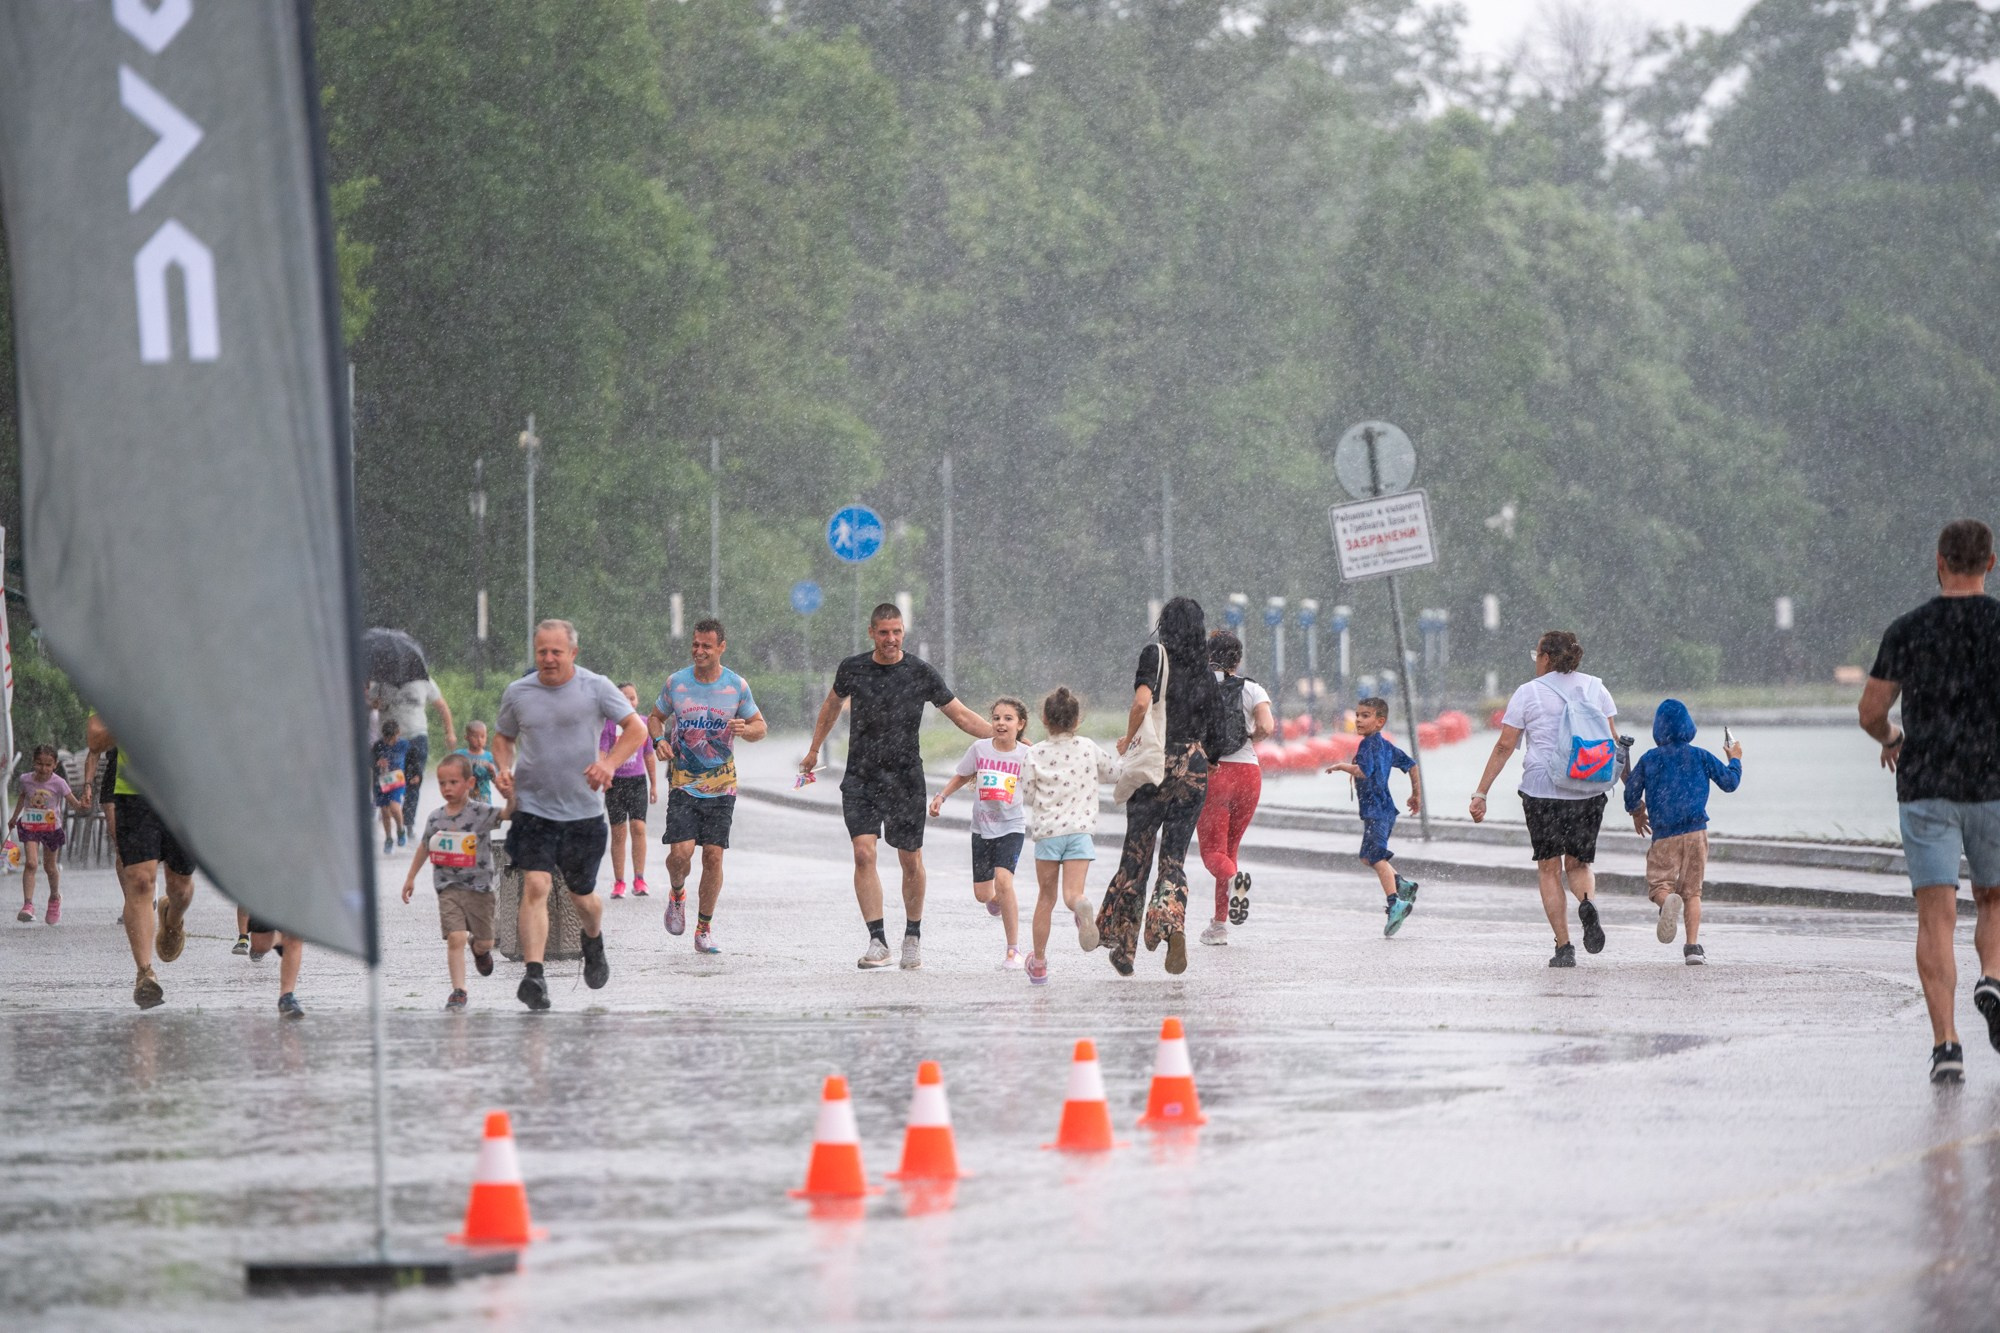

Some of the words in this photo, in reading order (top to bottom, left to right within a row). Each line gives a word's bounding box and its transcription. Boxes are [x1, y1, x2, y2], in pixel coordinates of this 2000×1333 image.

[677, 716, 727, 730] Бачково
[1577, 741, 1611, 766] NIKE
[983, 775, 998, 786] 23
[26, 813, 42, 821] 110
[438, 838, 453, 851] 41
